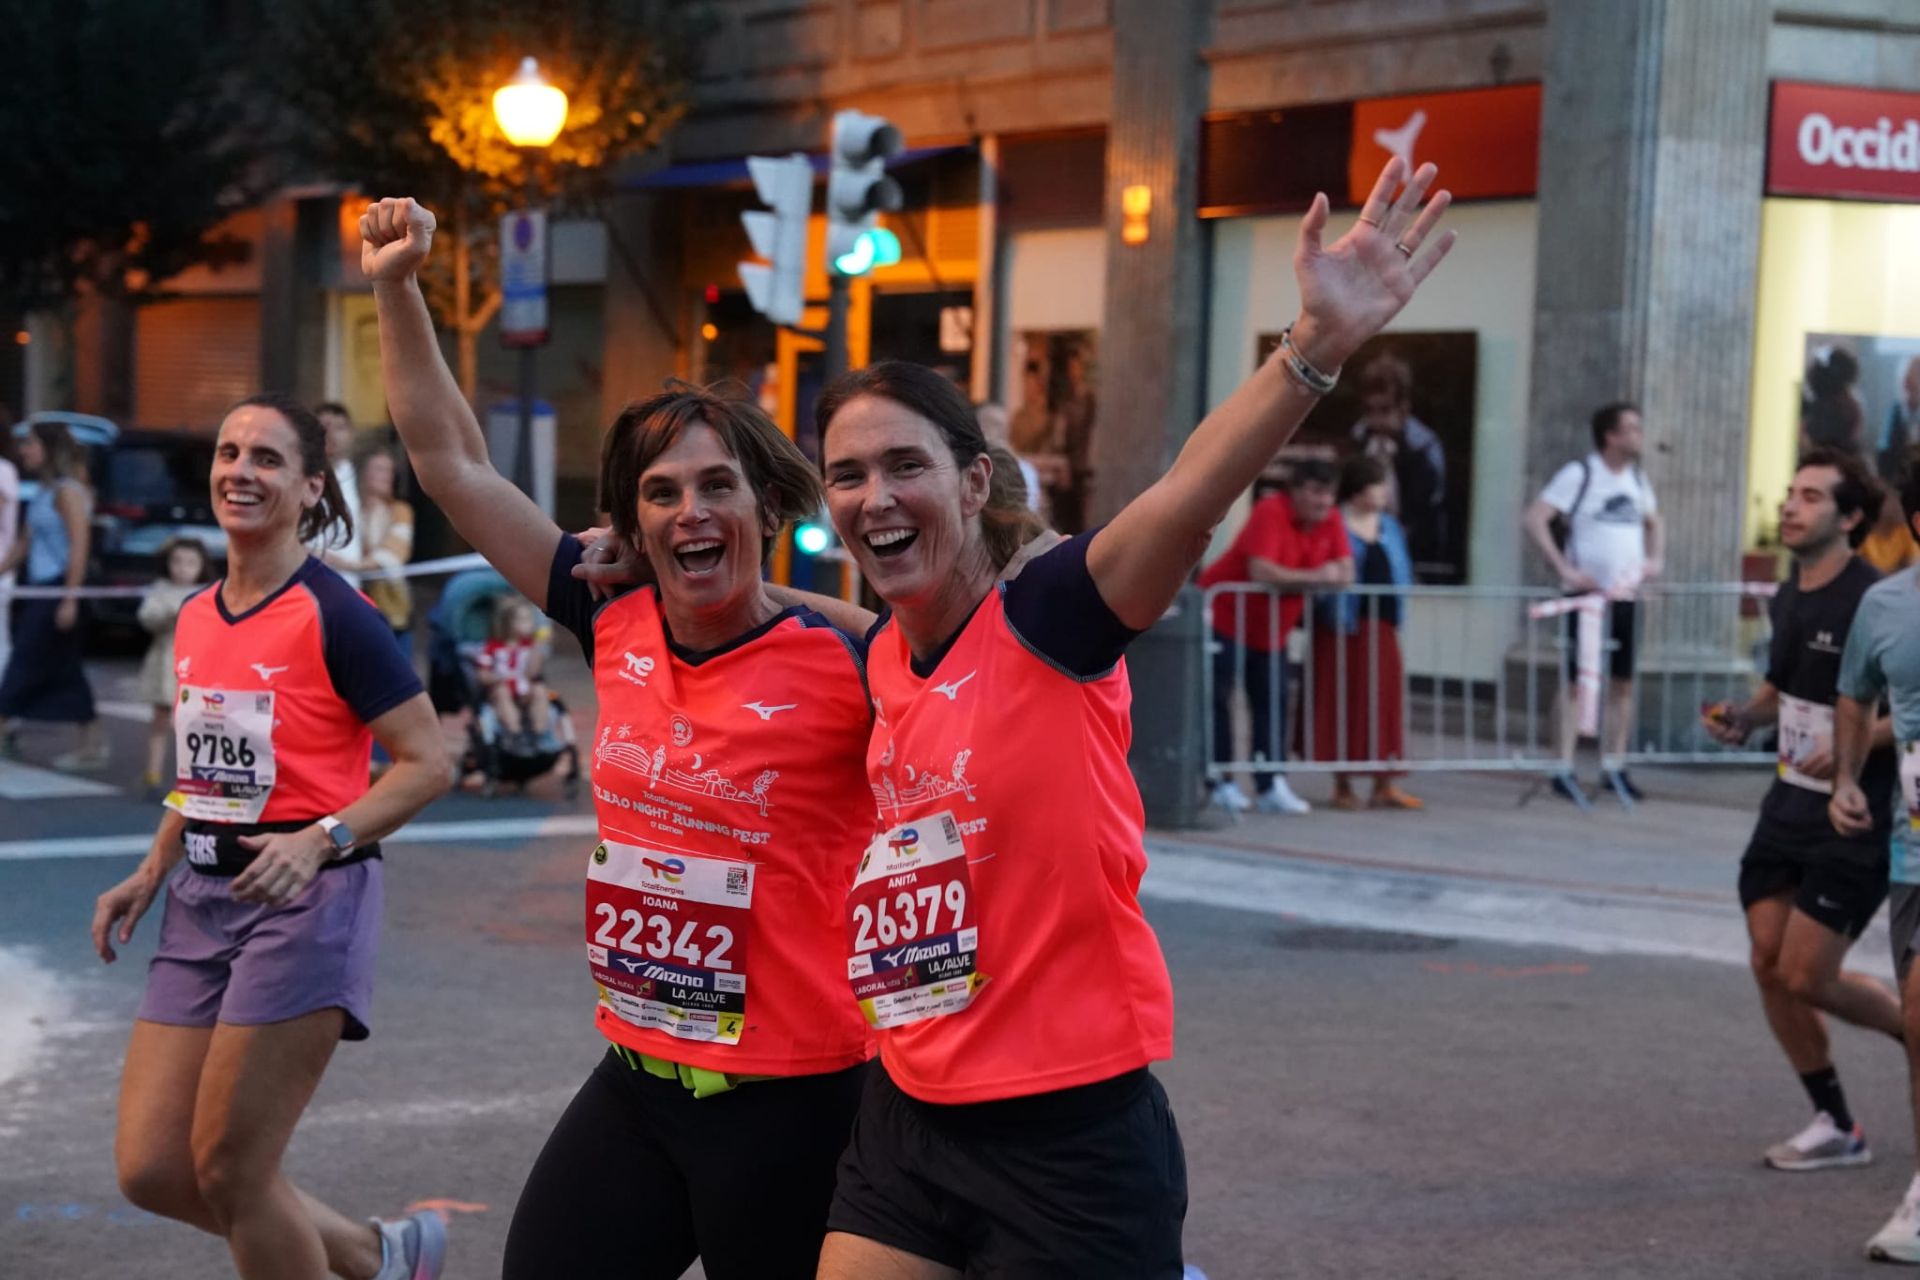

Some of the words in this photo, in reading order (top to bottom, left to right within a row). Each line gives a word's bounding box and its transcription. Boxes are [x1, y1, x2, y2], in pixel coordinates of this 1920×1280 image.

[187, 733, 255, 768] 9786
[642, 790, 693, 812] TotalEnergies
[633, 801, 669, 819] NIGHT
[672, 812, 730, 834] RUNNING
[733, 829, 771, 844] FEST
[641, 881, 685, 896] TotalEnergies
[888, 873, 917, 889] ANITA
[642, 896, 679, 911] IOANA
[852, 880, 966, 953] 26379
[594, 902, 734, 970] 22342
[904, 942, 951, 964] MIZUNO
[928, 960, 941, 975] LA
[941, 954, 971, 972] SALVE
[643, 965, 704, 988] MIZUNO
[854, 979, 887, 995] LABORAL
[672, 987, 686, 1000] LA
[688, 991, 726, 1004] SALVE
